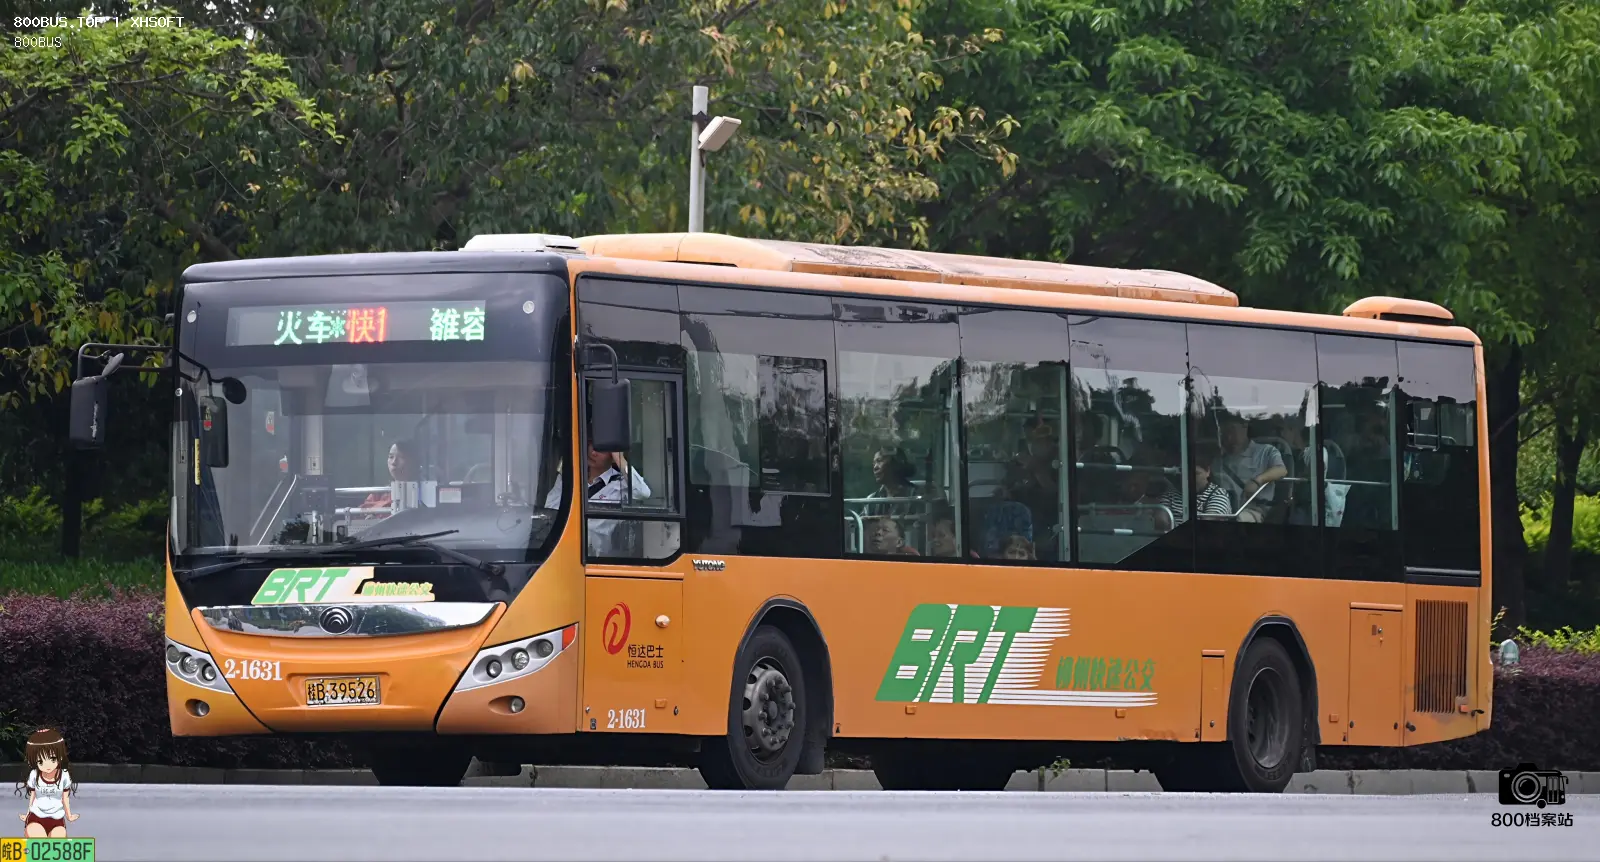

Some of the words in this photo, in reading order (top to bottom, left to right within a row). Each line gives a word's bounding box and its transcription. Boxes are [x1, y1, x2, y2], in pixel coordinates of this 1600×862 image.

[692, 559, 726, 572] YUTONG
[252, 568, 350, 604] BRT
[627, 644, 664, 659] 恒达巴士
[874, 603, 1039, 703] BRT
[627, 660, 651, 669] HENGDA
[653, 660, 664, 669] BUS
